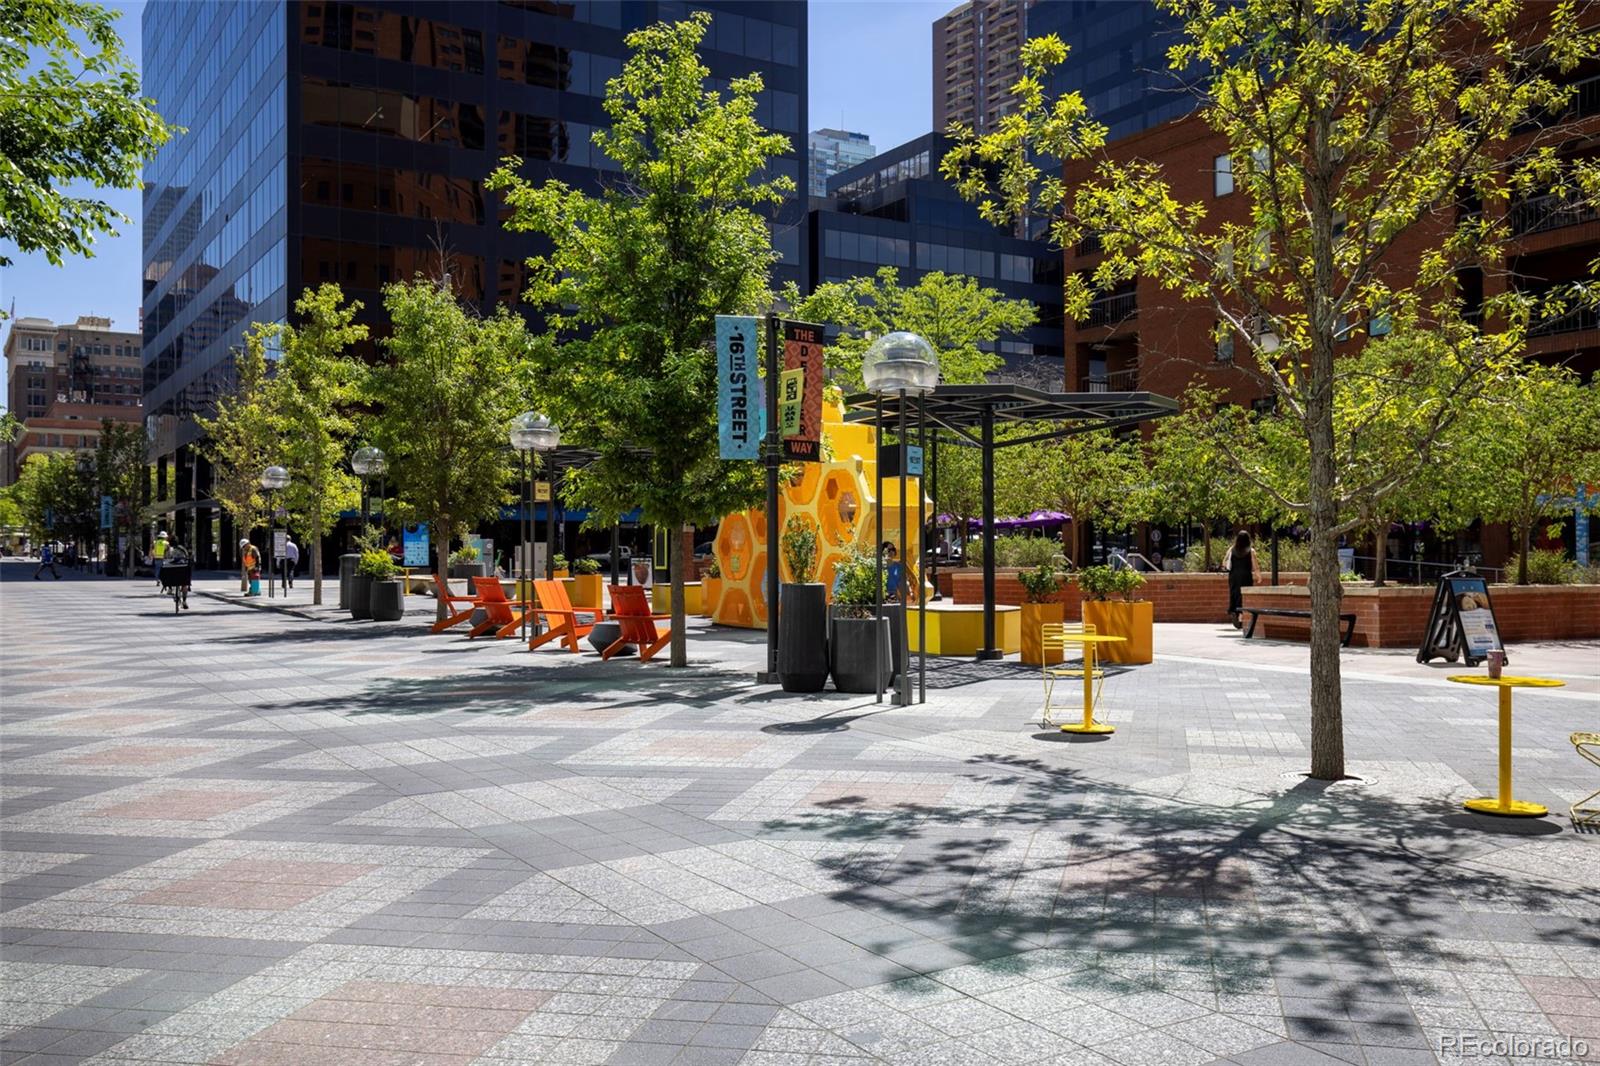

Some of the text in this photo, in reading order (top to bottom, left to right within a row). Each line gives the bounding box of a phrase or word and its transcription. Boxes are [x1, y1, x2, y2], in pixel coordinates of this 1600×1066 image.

[794, 329, 815, 341] THE
[730, 372, 747, 443] STREET
[791, 441, 813, 454] WAY
